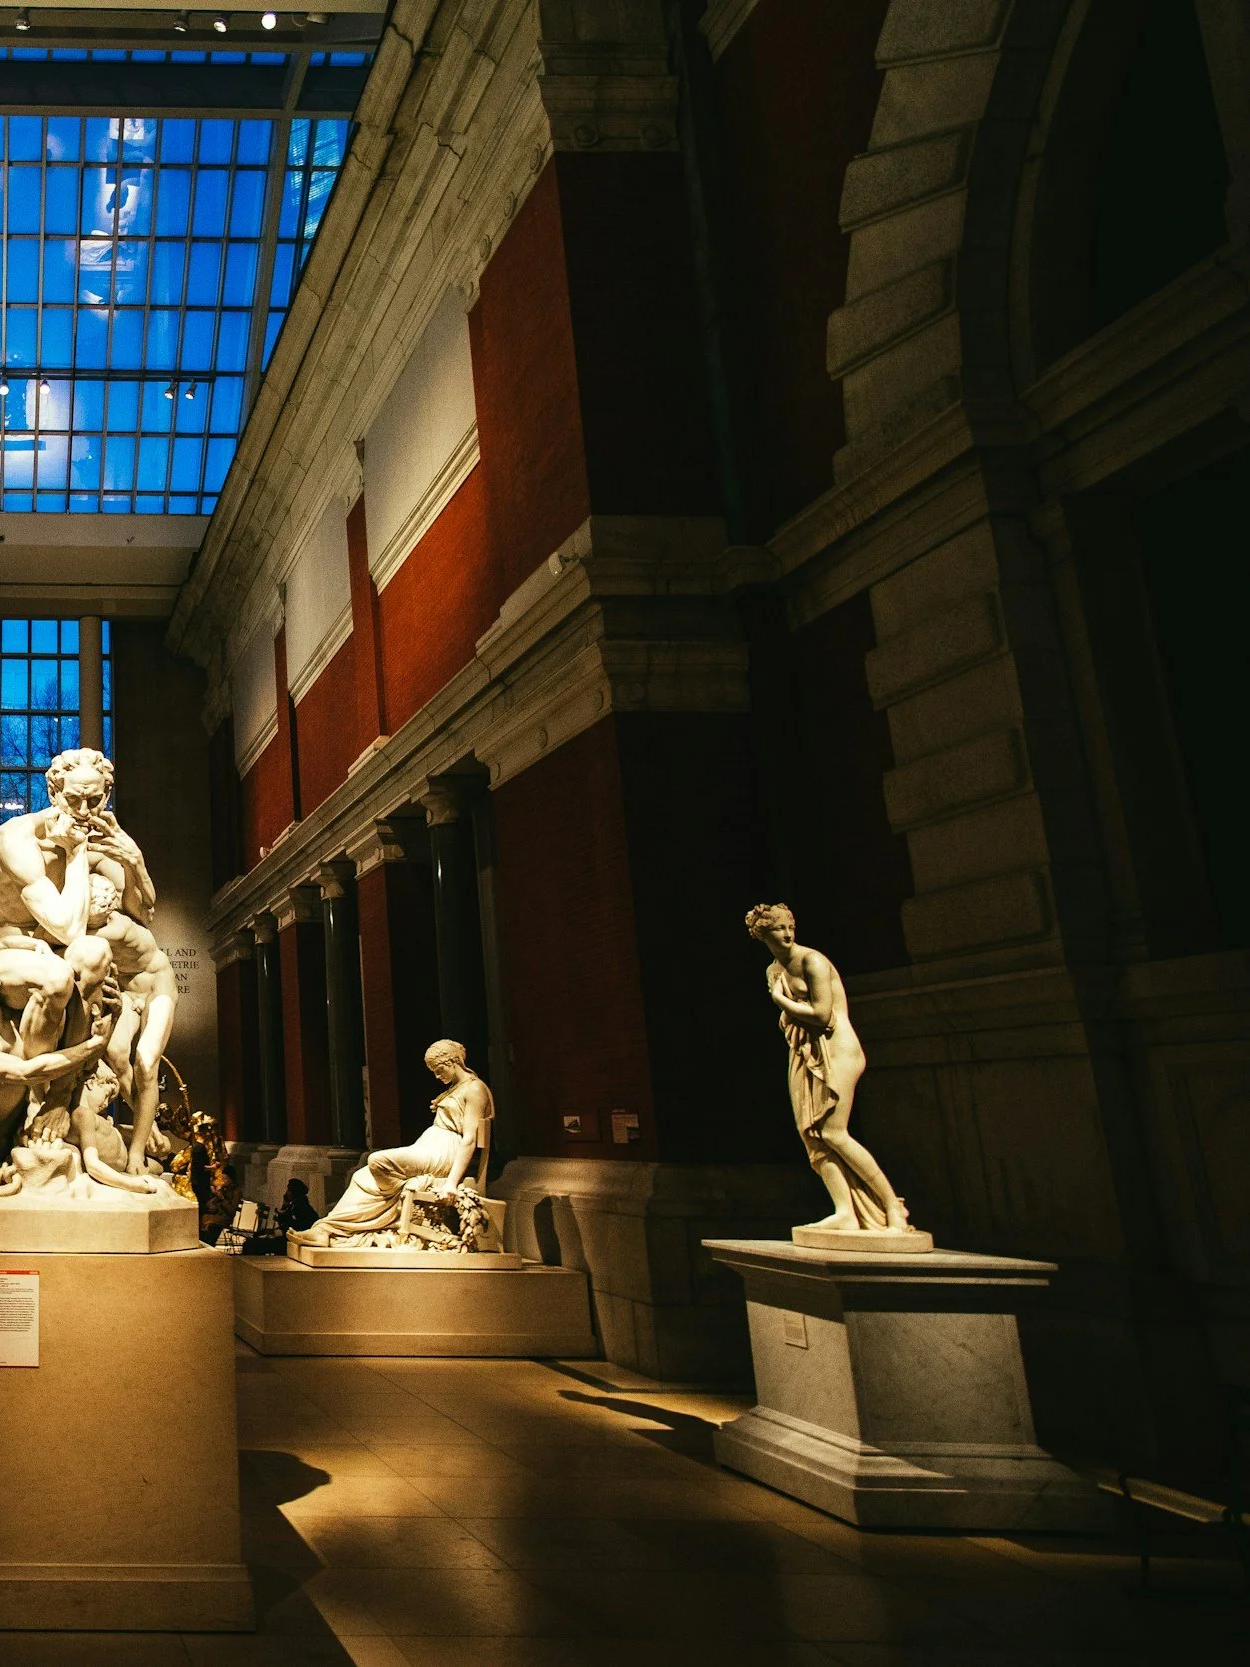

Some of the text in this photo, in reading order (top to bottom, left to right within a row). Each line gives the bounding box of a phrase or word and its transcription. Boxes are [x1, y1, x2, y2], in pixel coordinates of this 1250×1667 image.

[174, 948, 197, 957] AND
[169, 961, 200, 969] ETRIE
[176, 985, 191, 994] RE
